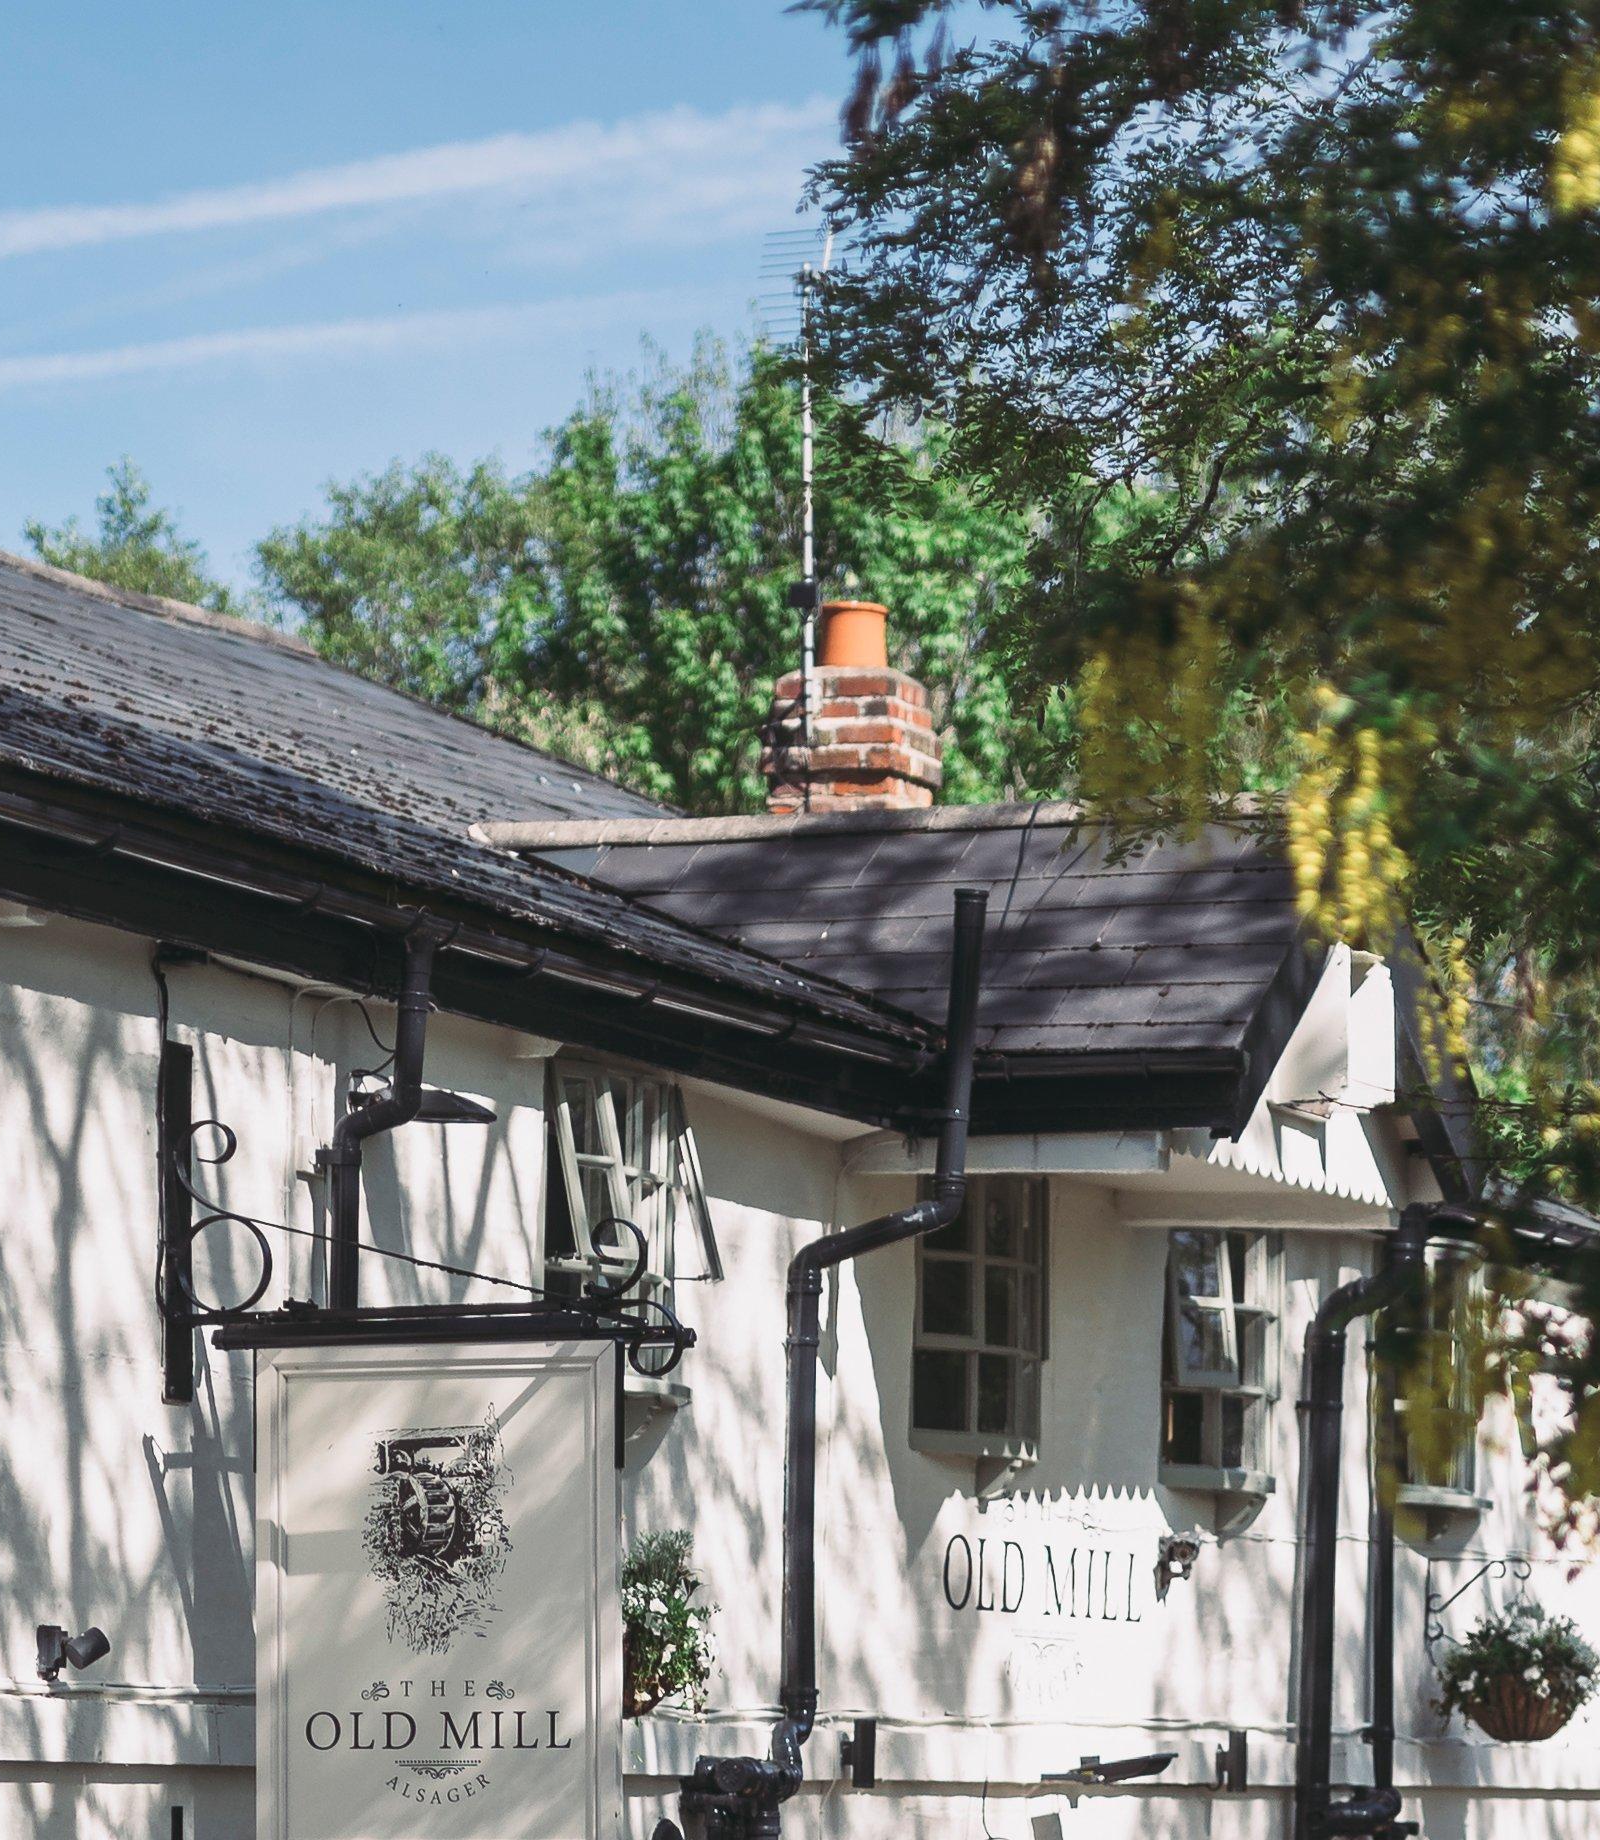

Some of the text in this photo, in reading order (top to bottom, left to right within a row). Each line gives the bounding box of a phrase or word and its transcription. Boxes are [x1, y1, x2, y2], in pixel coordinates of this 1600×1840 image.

[943, 1534, 1142, 1623] OLD MILL
[400, 1680, 476, 1697] THE
[305, 1710, 572, 1750] OLD MILL
[385, 1773, 491, 1804] ALSAGER
